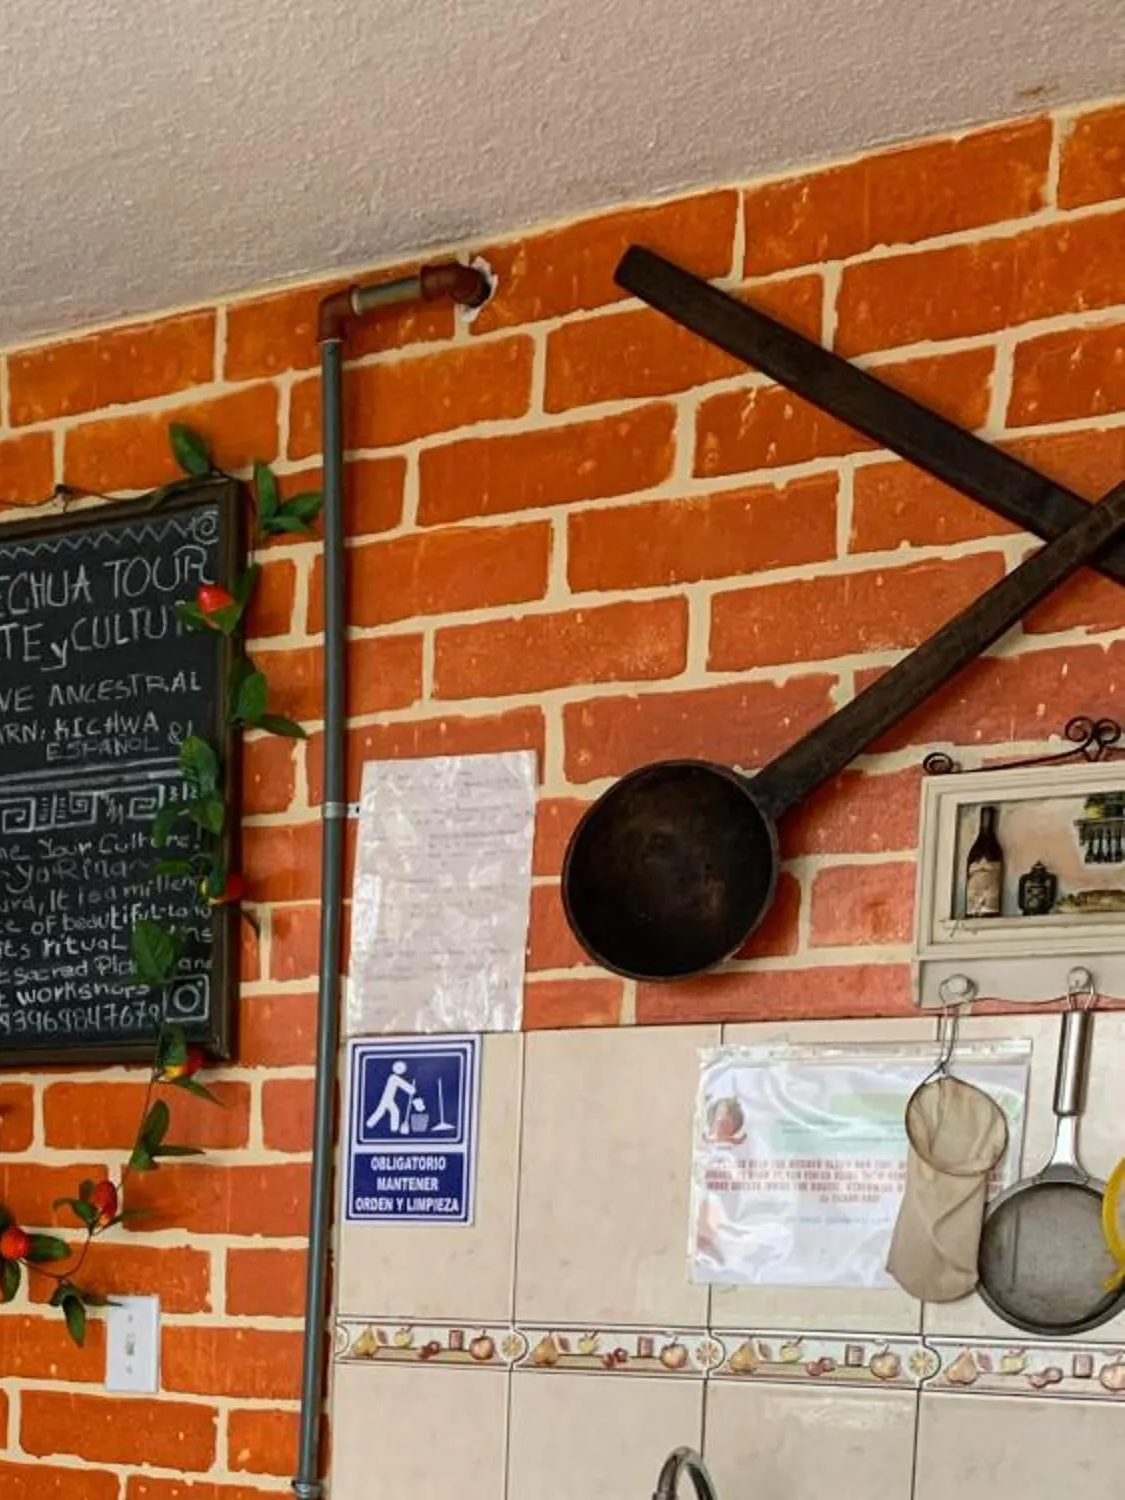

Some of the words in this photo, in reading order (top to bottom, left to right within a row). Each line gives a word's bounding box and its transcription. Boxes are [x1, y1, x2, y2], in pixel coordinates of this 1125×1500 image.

[103, 545, 216, 598] TOUR
[48, 671, 203, 707] ANCESTRAL
[54, 710, 160, 741] KICHWA
[37, 837, 93, 860] Your
[370, 1156, 447, 1171] OBLIGATORIO
[376, 1176, 440, 1192] MANTENER
[355, 1197, 394, 1212] ORDEN
[395, 1197, 405, 1212] Y
[406, 1197, 460, 1213] LIMPIEZA
